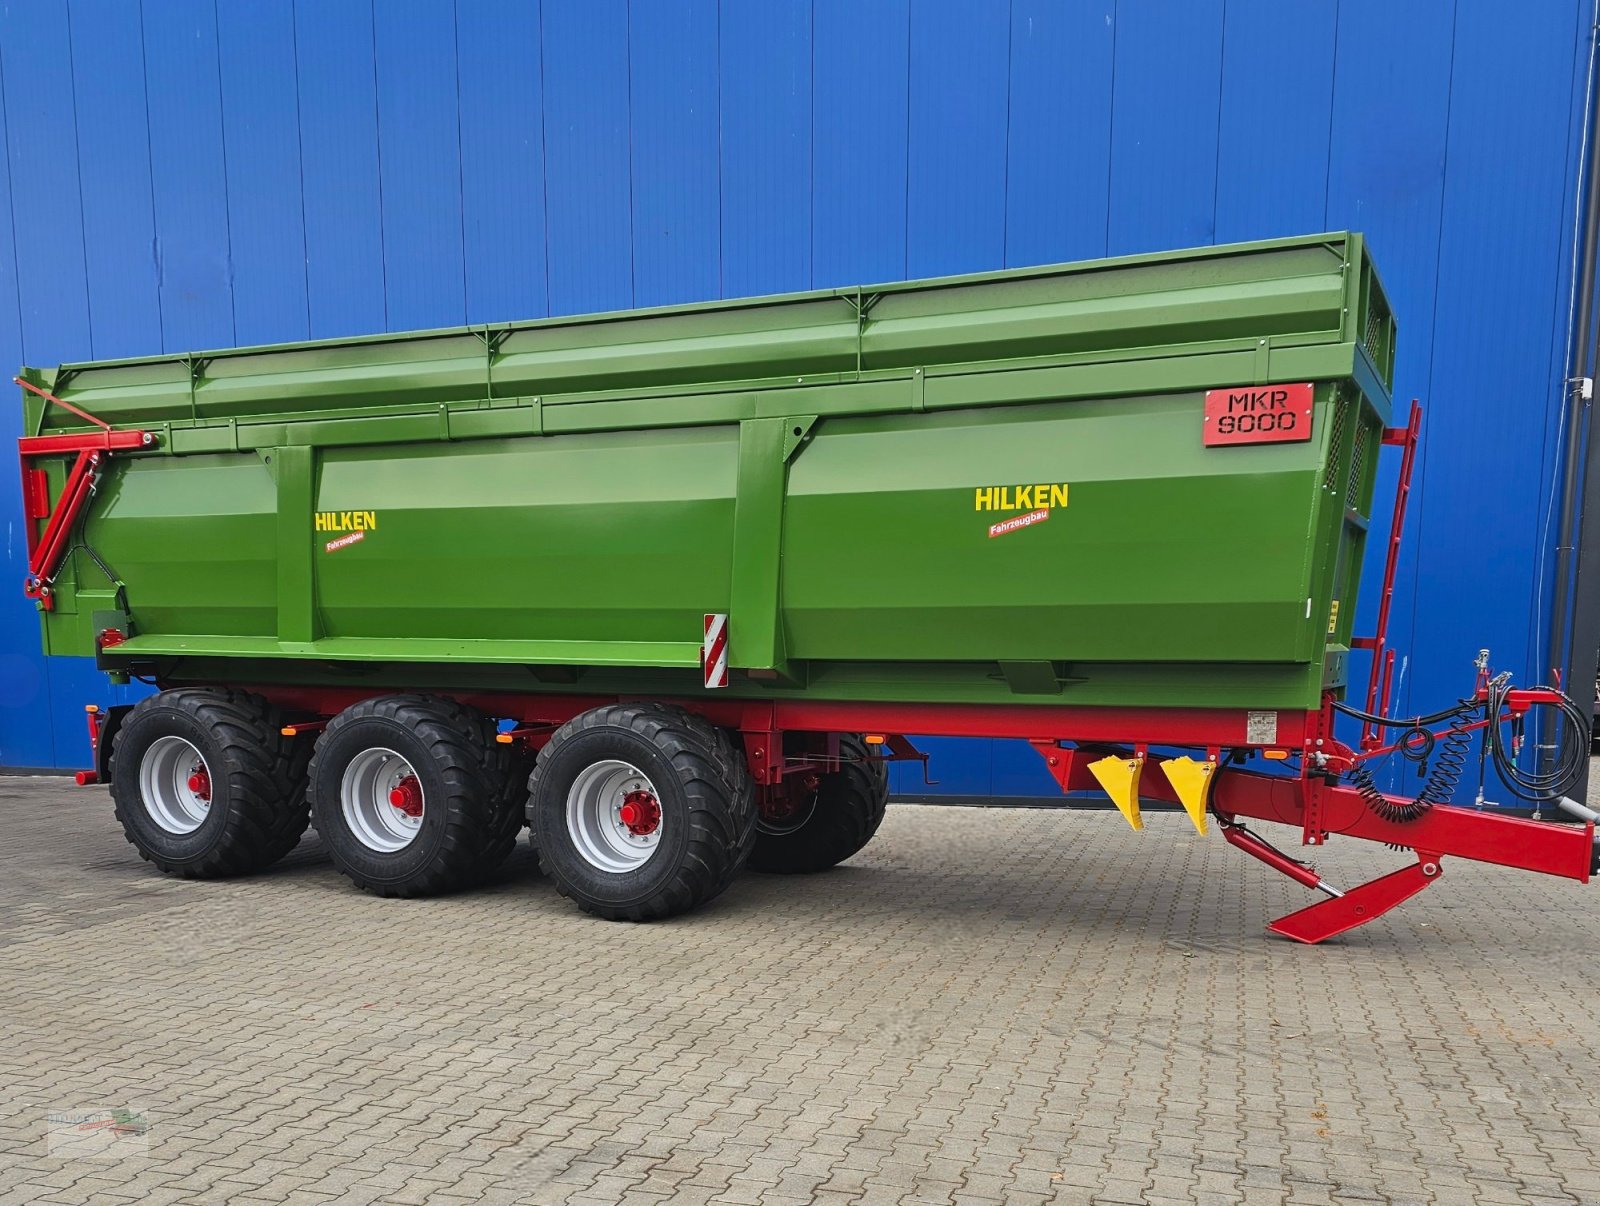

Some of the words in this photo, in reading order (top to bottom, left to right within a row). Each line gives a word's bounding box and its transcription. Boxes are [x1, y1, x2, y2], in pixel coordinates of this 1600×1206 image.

[1228, 391, 1288, 412] MKR
[1218, 412, 1296, 434] 9000
[975, 483, 1069, 511] HILKEN
[315, 511, 376, 531] HILKEN
[990, 510, 1048, 535] Fahrzeugbau
[326, 531, 364, 551] Fahrzeugbau
